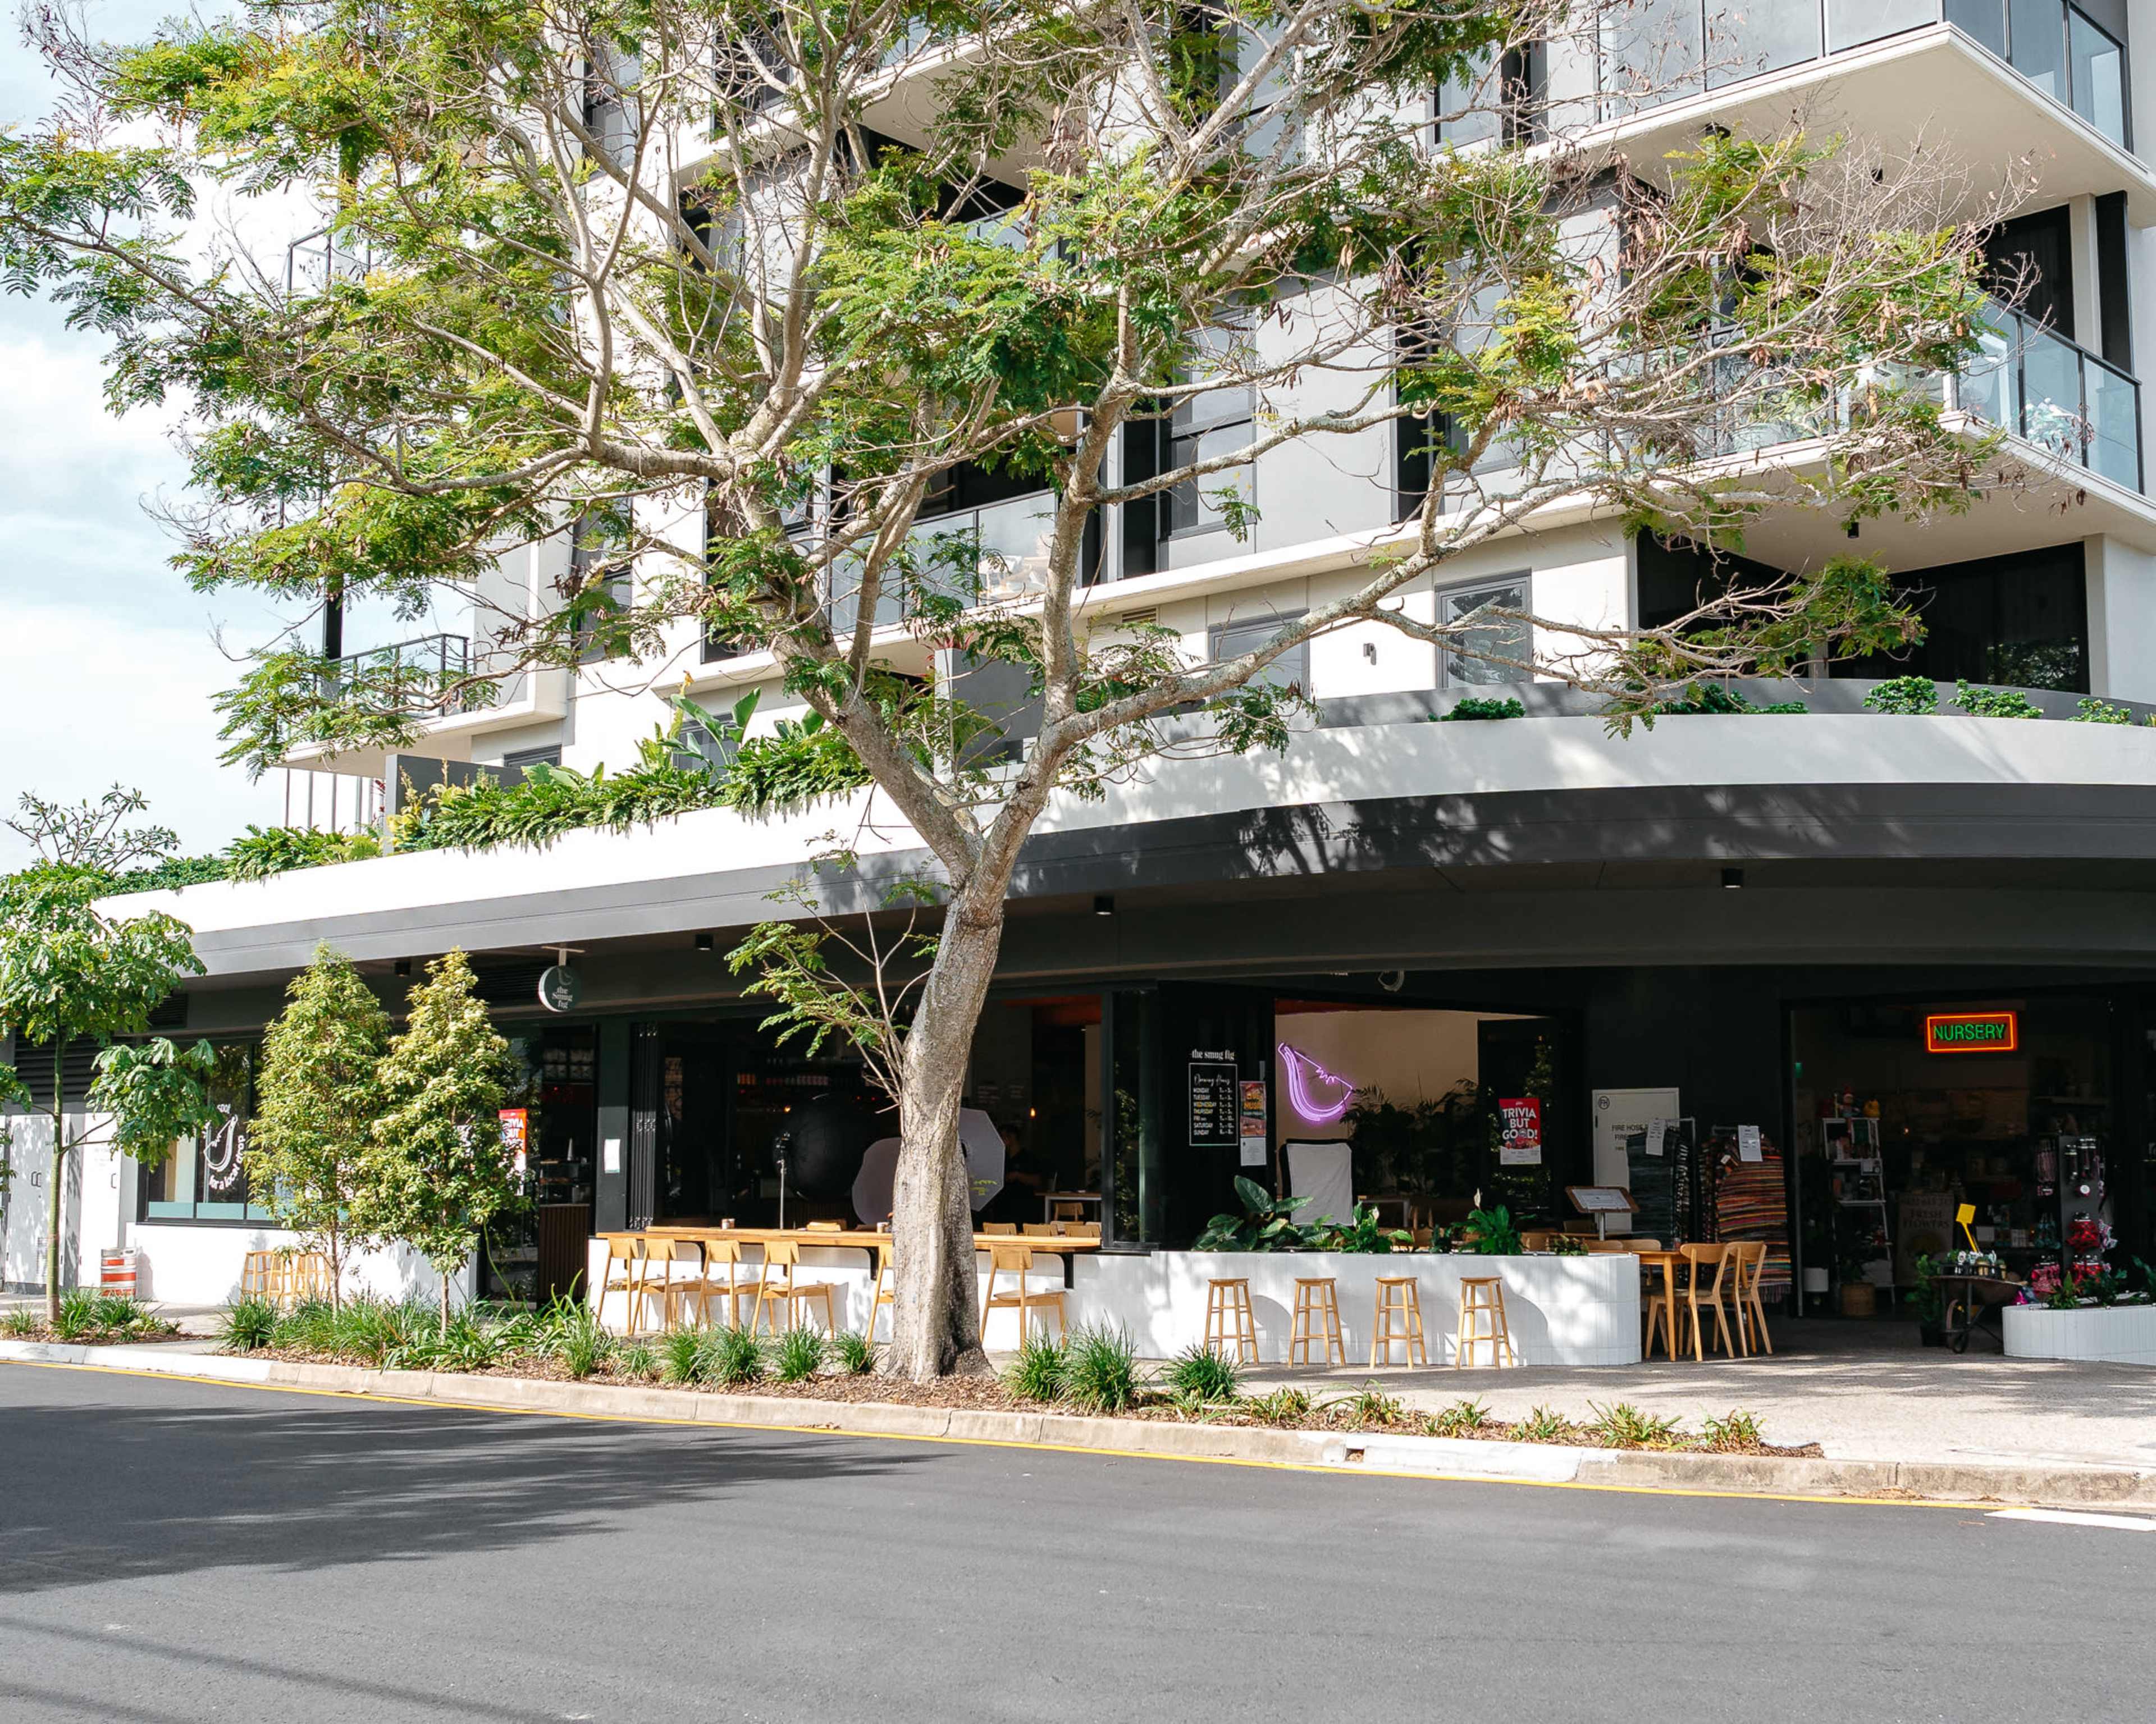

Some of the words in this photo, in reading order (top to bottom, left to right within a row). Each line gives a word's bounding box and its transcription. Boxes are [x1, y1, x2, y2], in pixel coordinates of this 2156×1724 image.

[1933, 1023, 2005, 1041] NURSERY
[1191, 1049, 1203, 1058] the
[1204, 1050, 1223, 1060] smug
[1225, 1050, 1235, 1060] fig
[1502, 1107, 1536, 1119] TRIVIA
[1510, 1118, 1529, 1128] BUT
[209, 1174, 219, 1190] for
[219, 1180, 225, 1190] a
[223, 1163, 240, 1187] local
[235, 1135, 245, 1164] drop
